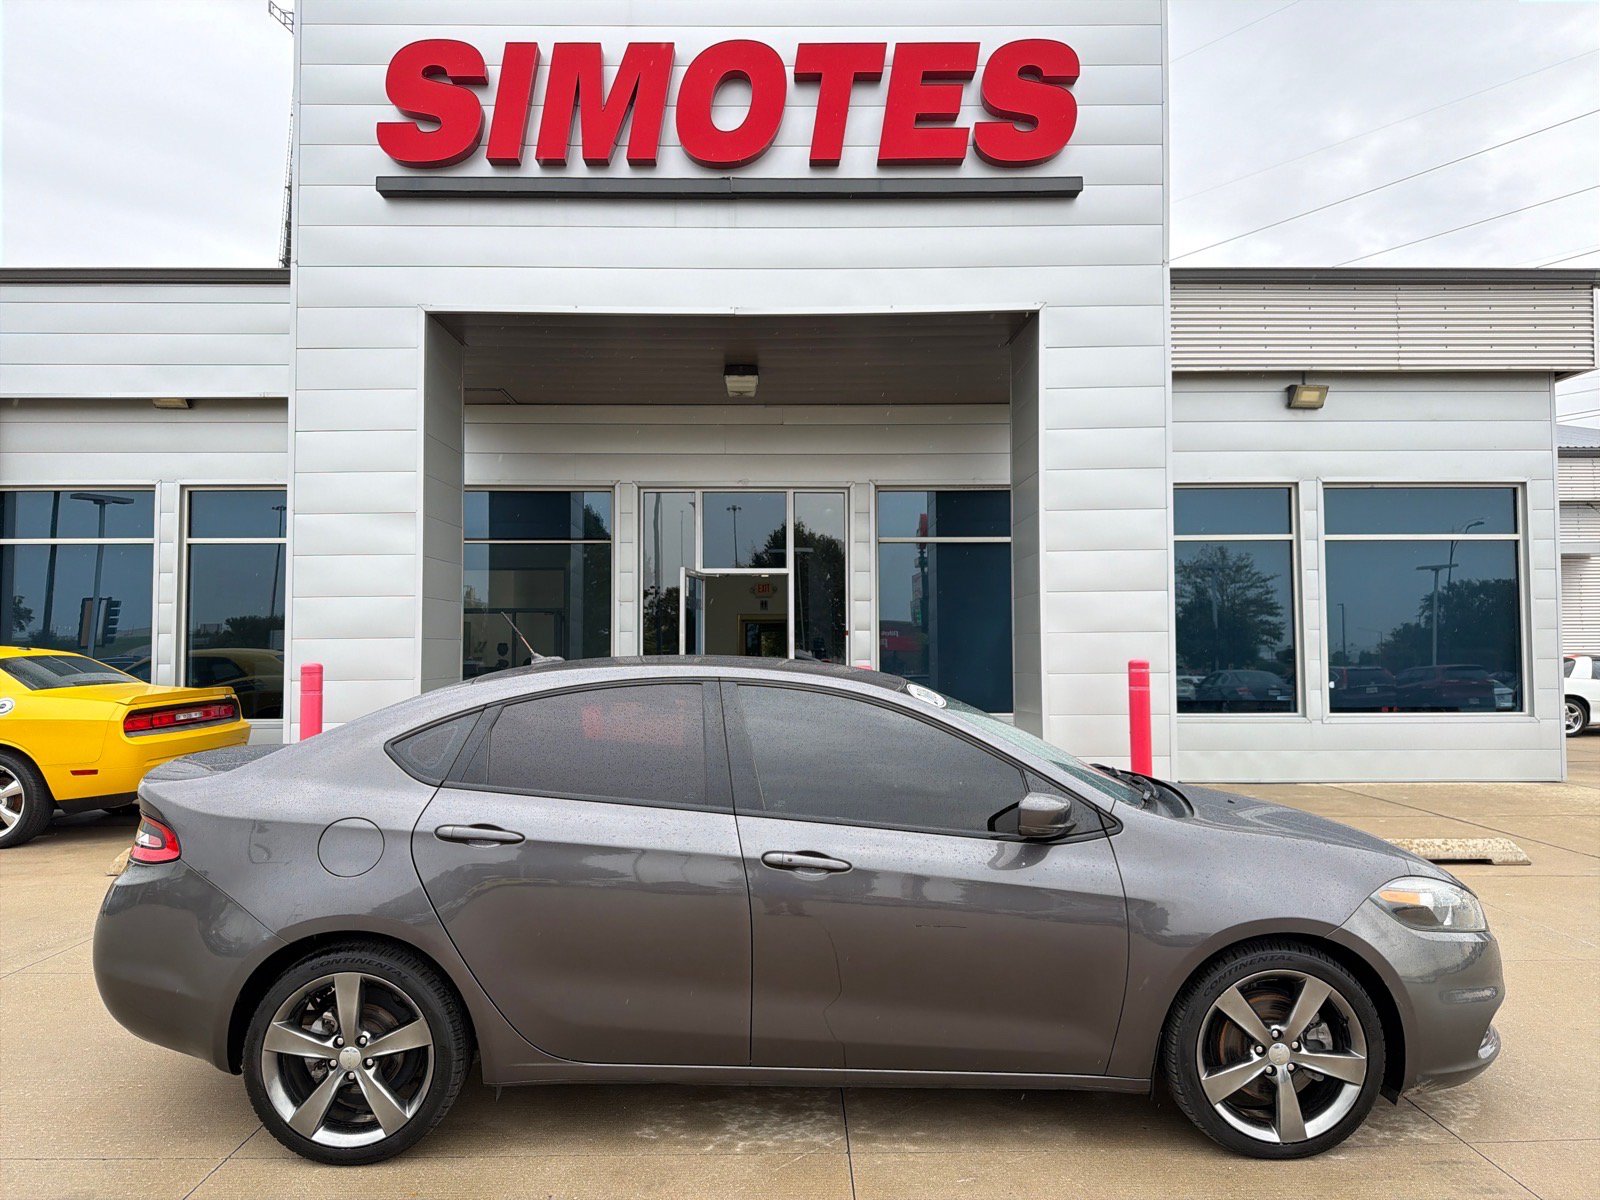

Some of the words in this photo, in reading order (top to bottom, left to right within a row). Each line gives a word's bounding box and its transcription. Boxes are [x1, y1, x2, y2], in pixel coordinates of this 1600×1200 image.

[376, 39, 1080, 169] SIMOTES
[757, 583, 770, 593] EXIT
[310, 957, 409, 980] CONTINENTAL
[1204, 955, 1294, 996] CONTINENTAL
